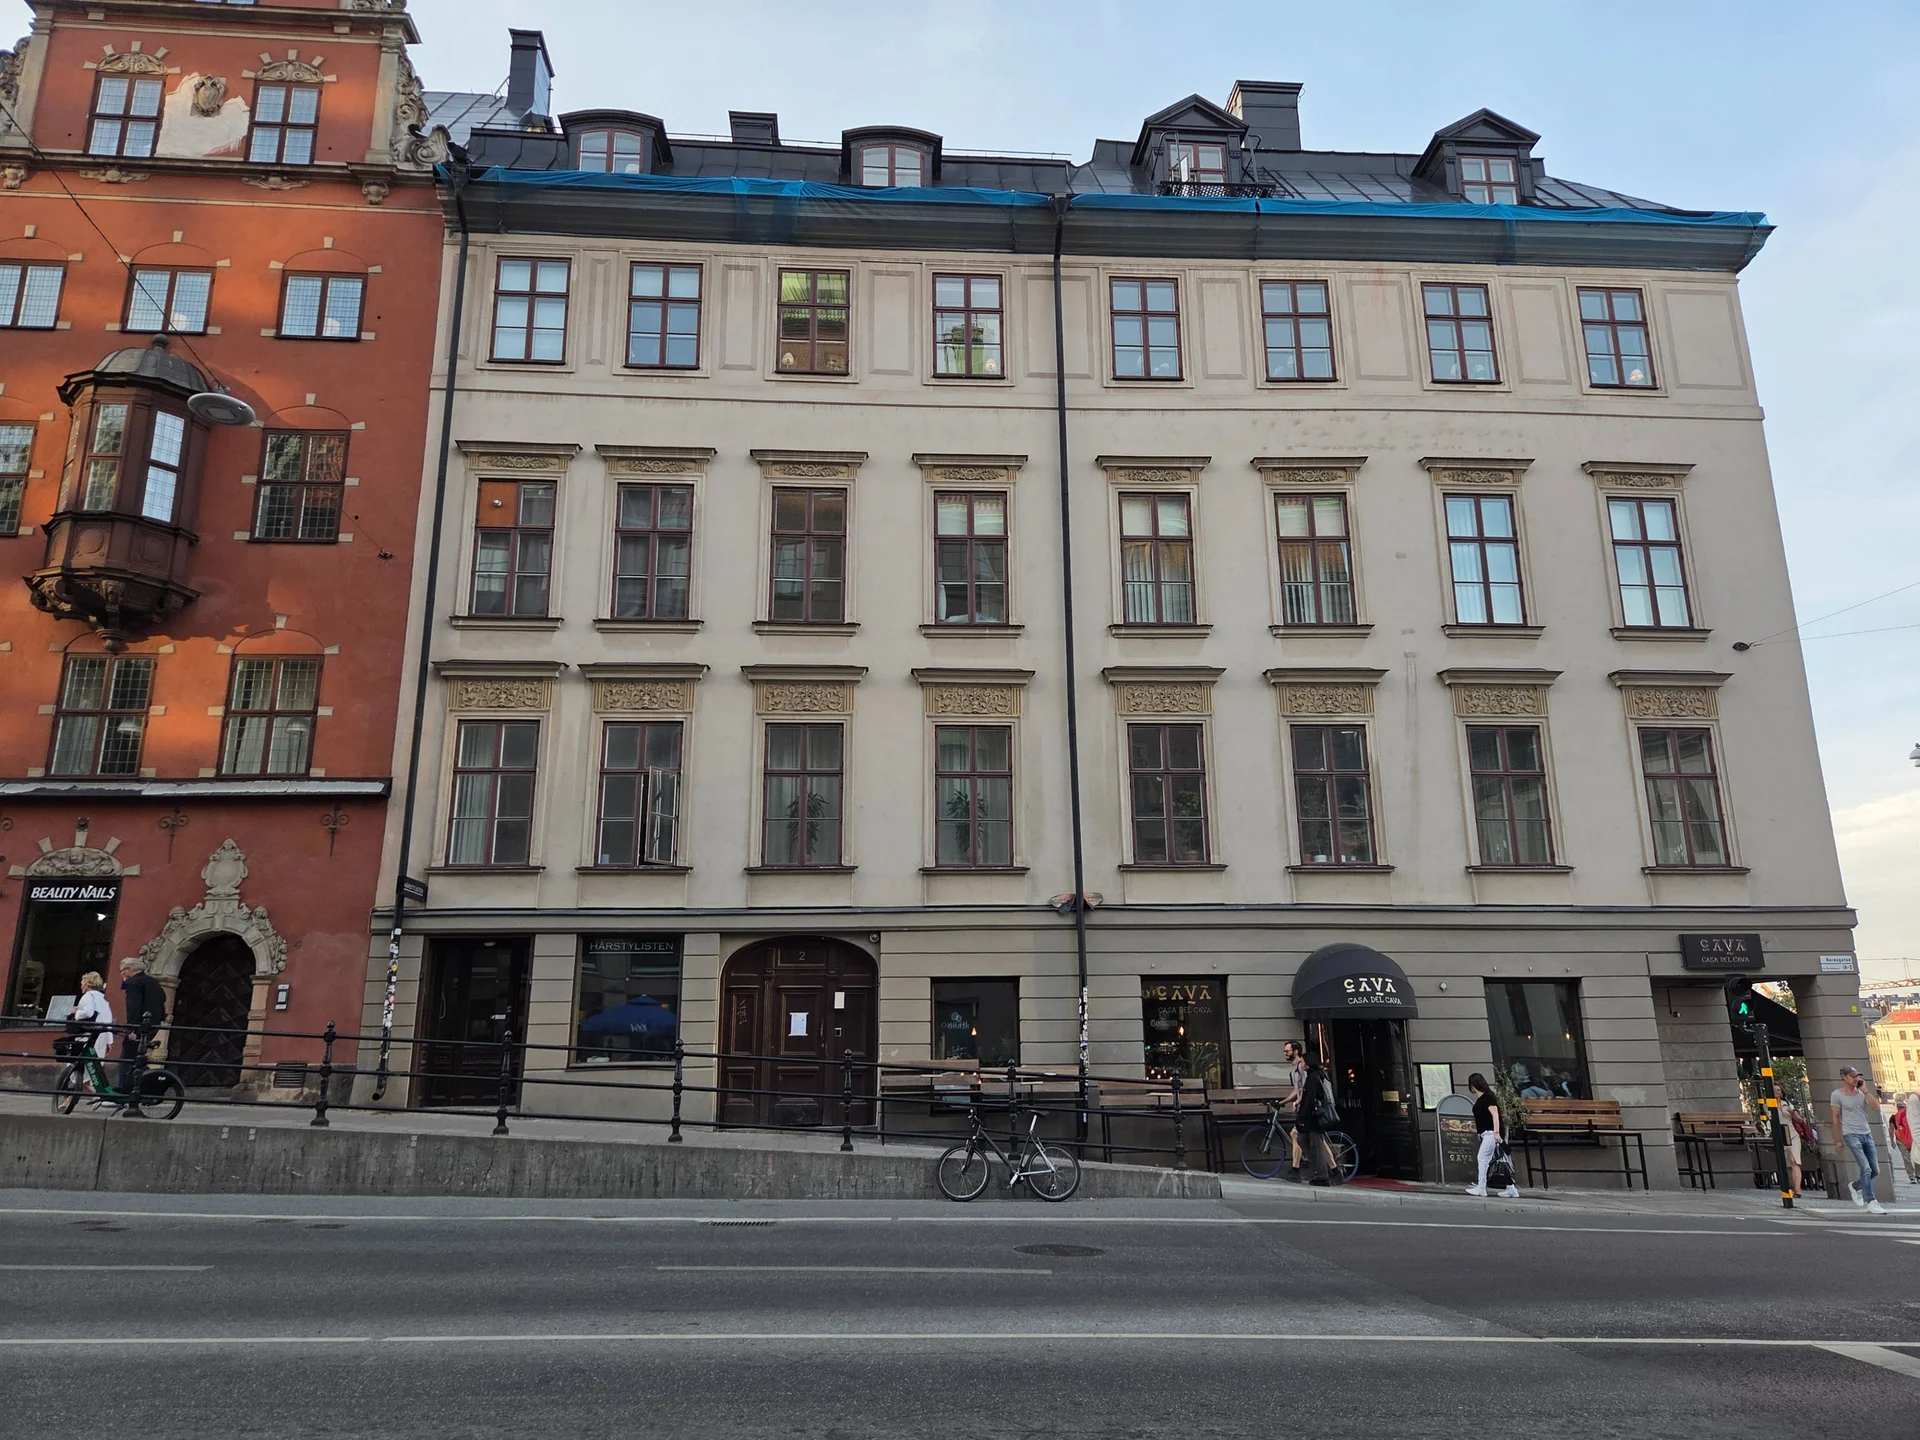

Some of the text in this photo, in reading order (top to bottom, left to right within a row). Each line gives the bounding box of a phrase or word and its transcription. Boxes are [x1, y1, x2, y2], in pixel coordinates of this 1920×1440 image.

[31, 885, 117, 899] BEAUTY NAILS
[590, 941, 674, 951] HÅRSTYLISTEN
[1700, 939, 1747, 955] CAVA
[799, 951, 806, 960] 2
[1343, 977, 1397, 996] CAVA
[1158, 985, 1211, 1004] CAVA
[1347, 996, 1369, 1005] CASA
[1384, 996, 1402, 1005] CAVA
